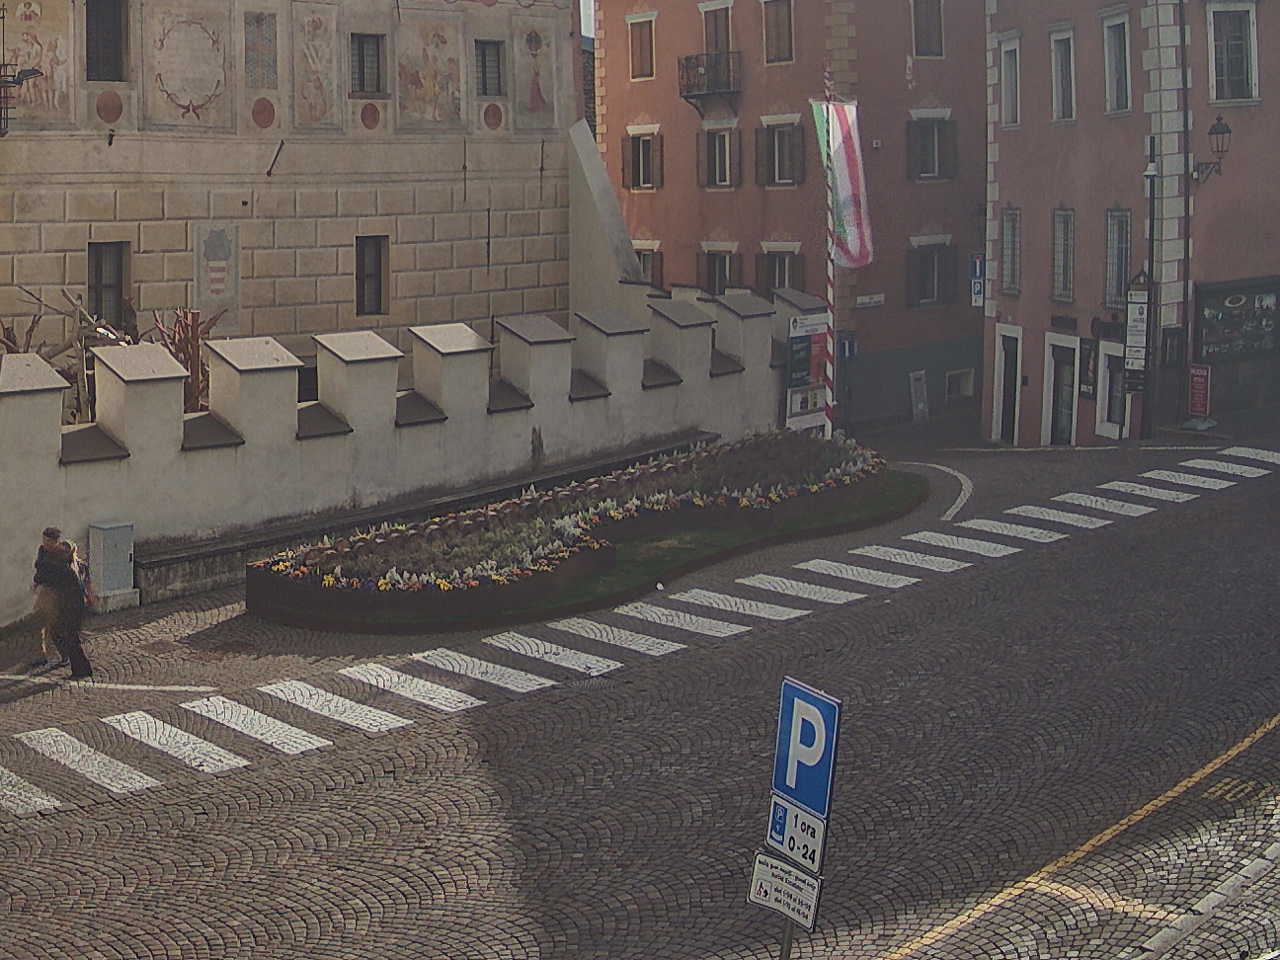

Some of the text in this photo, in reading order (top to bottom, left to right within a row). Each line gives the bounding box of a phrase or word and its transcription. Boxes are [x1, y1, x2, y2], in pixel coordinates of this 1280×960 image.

[786, 697, 826, 789] P
[793, 813, 816, 839] 1 ora
